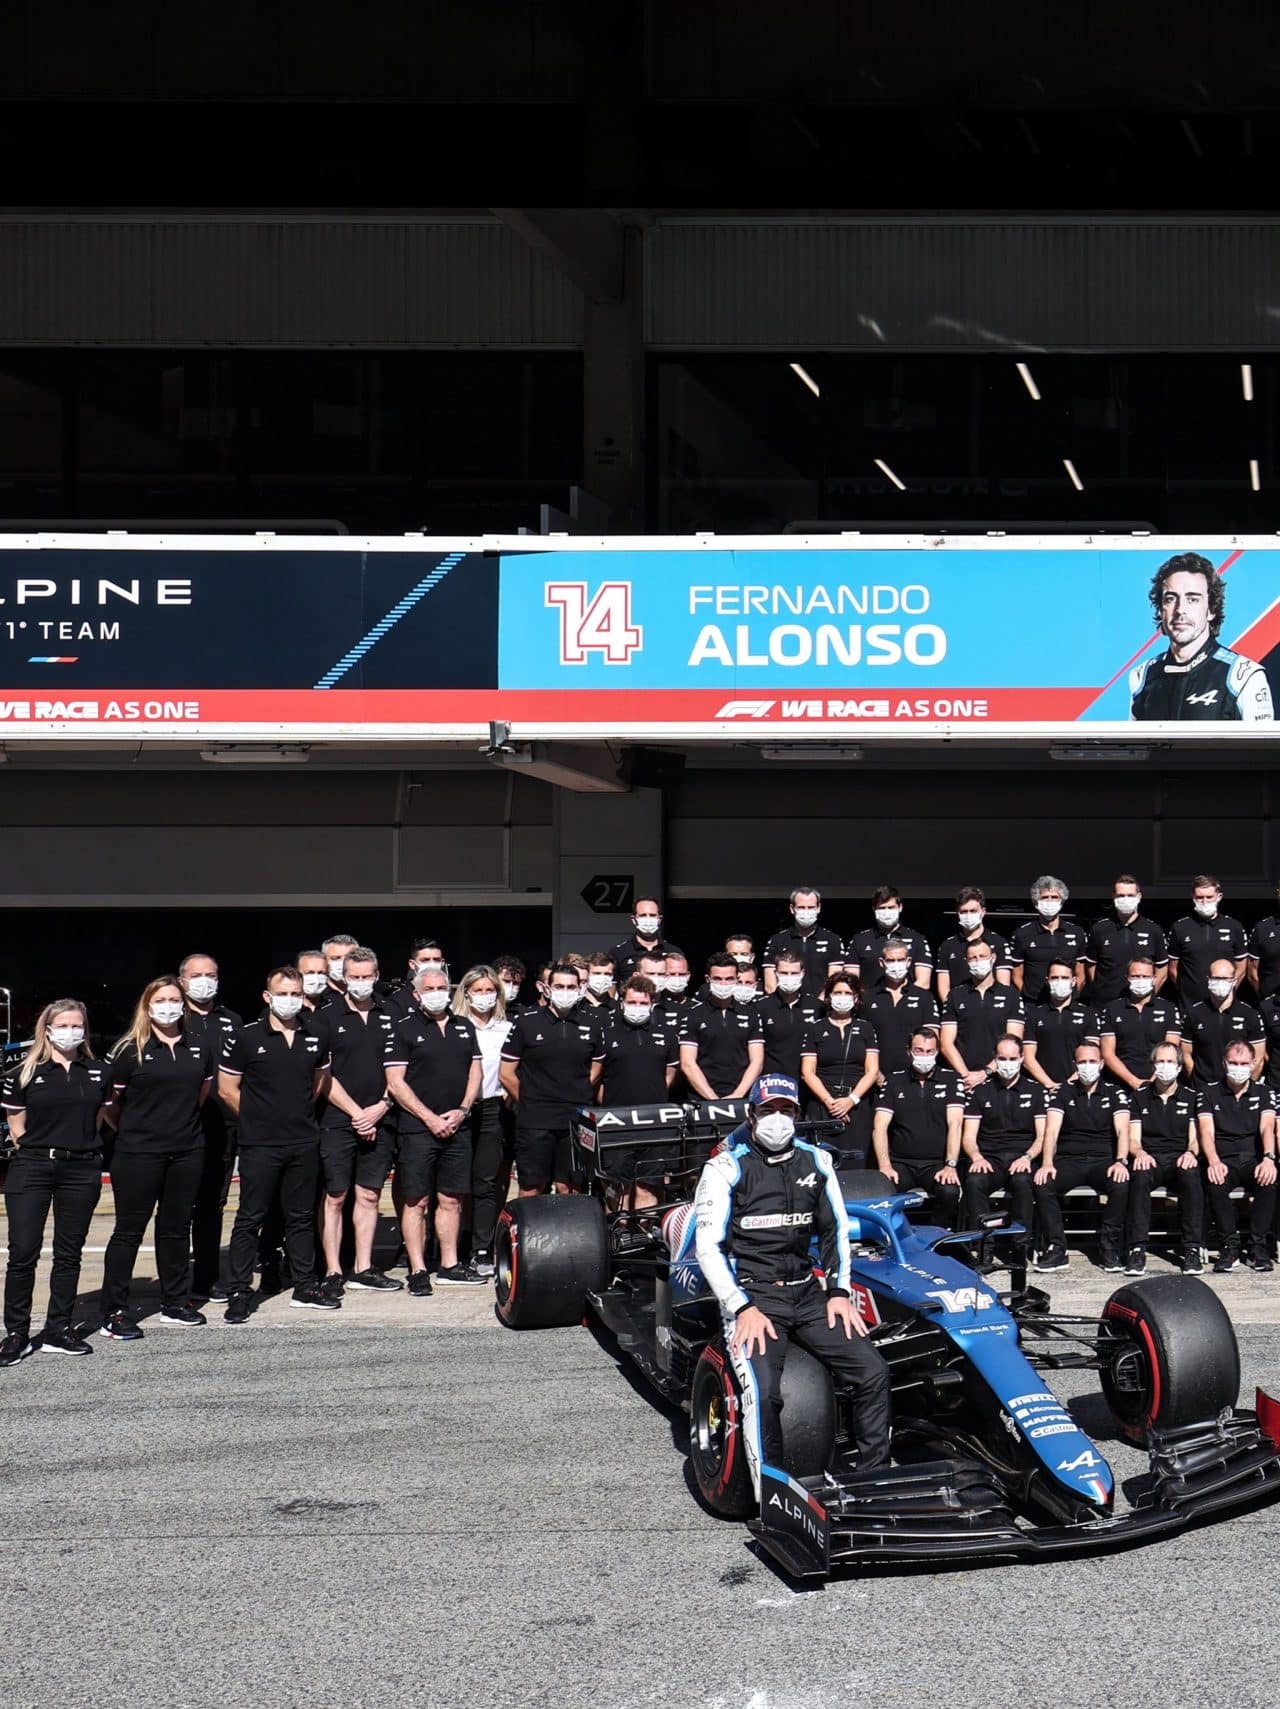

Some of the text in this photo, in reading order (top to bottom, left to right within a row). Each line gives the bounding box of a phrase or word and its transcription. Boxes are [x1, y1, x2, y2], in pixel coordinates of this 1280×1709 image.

[0, 579, 193, 605] PINE
[689, 585, 931, 615] FERNANDO
[38, 621, 121, 640] TEAM
[545, 581, 642, 665] 14
[687, 624, 947, 666] ALONSO
[34, 701, 99, 719] RACE
[103, 701, 141, 719] AS
[143, 701, 200, 719] ONE
[781, 700, 823, 718] WE
[827, 700, 890, 718] RACE
[894, 699, 930, 717] AS
[933, 699, 988, 718] ONE
[593, 881, 630, 907] 27
[759, 1078, 795, 1092] kimoa
[596, 1102, 751, 1128] ALPIN
[768, 1492, 825, 1550] ALPINE
